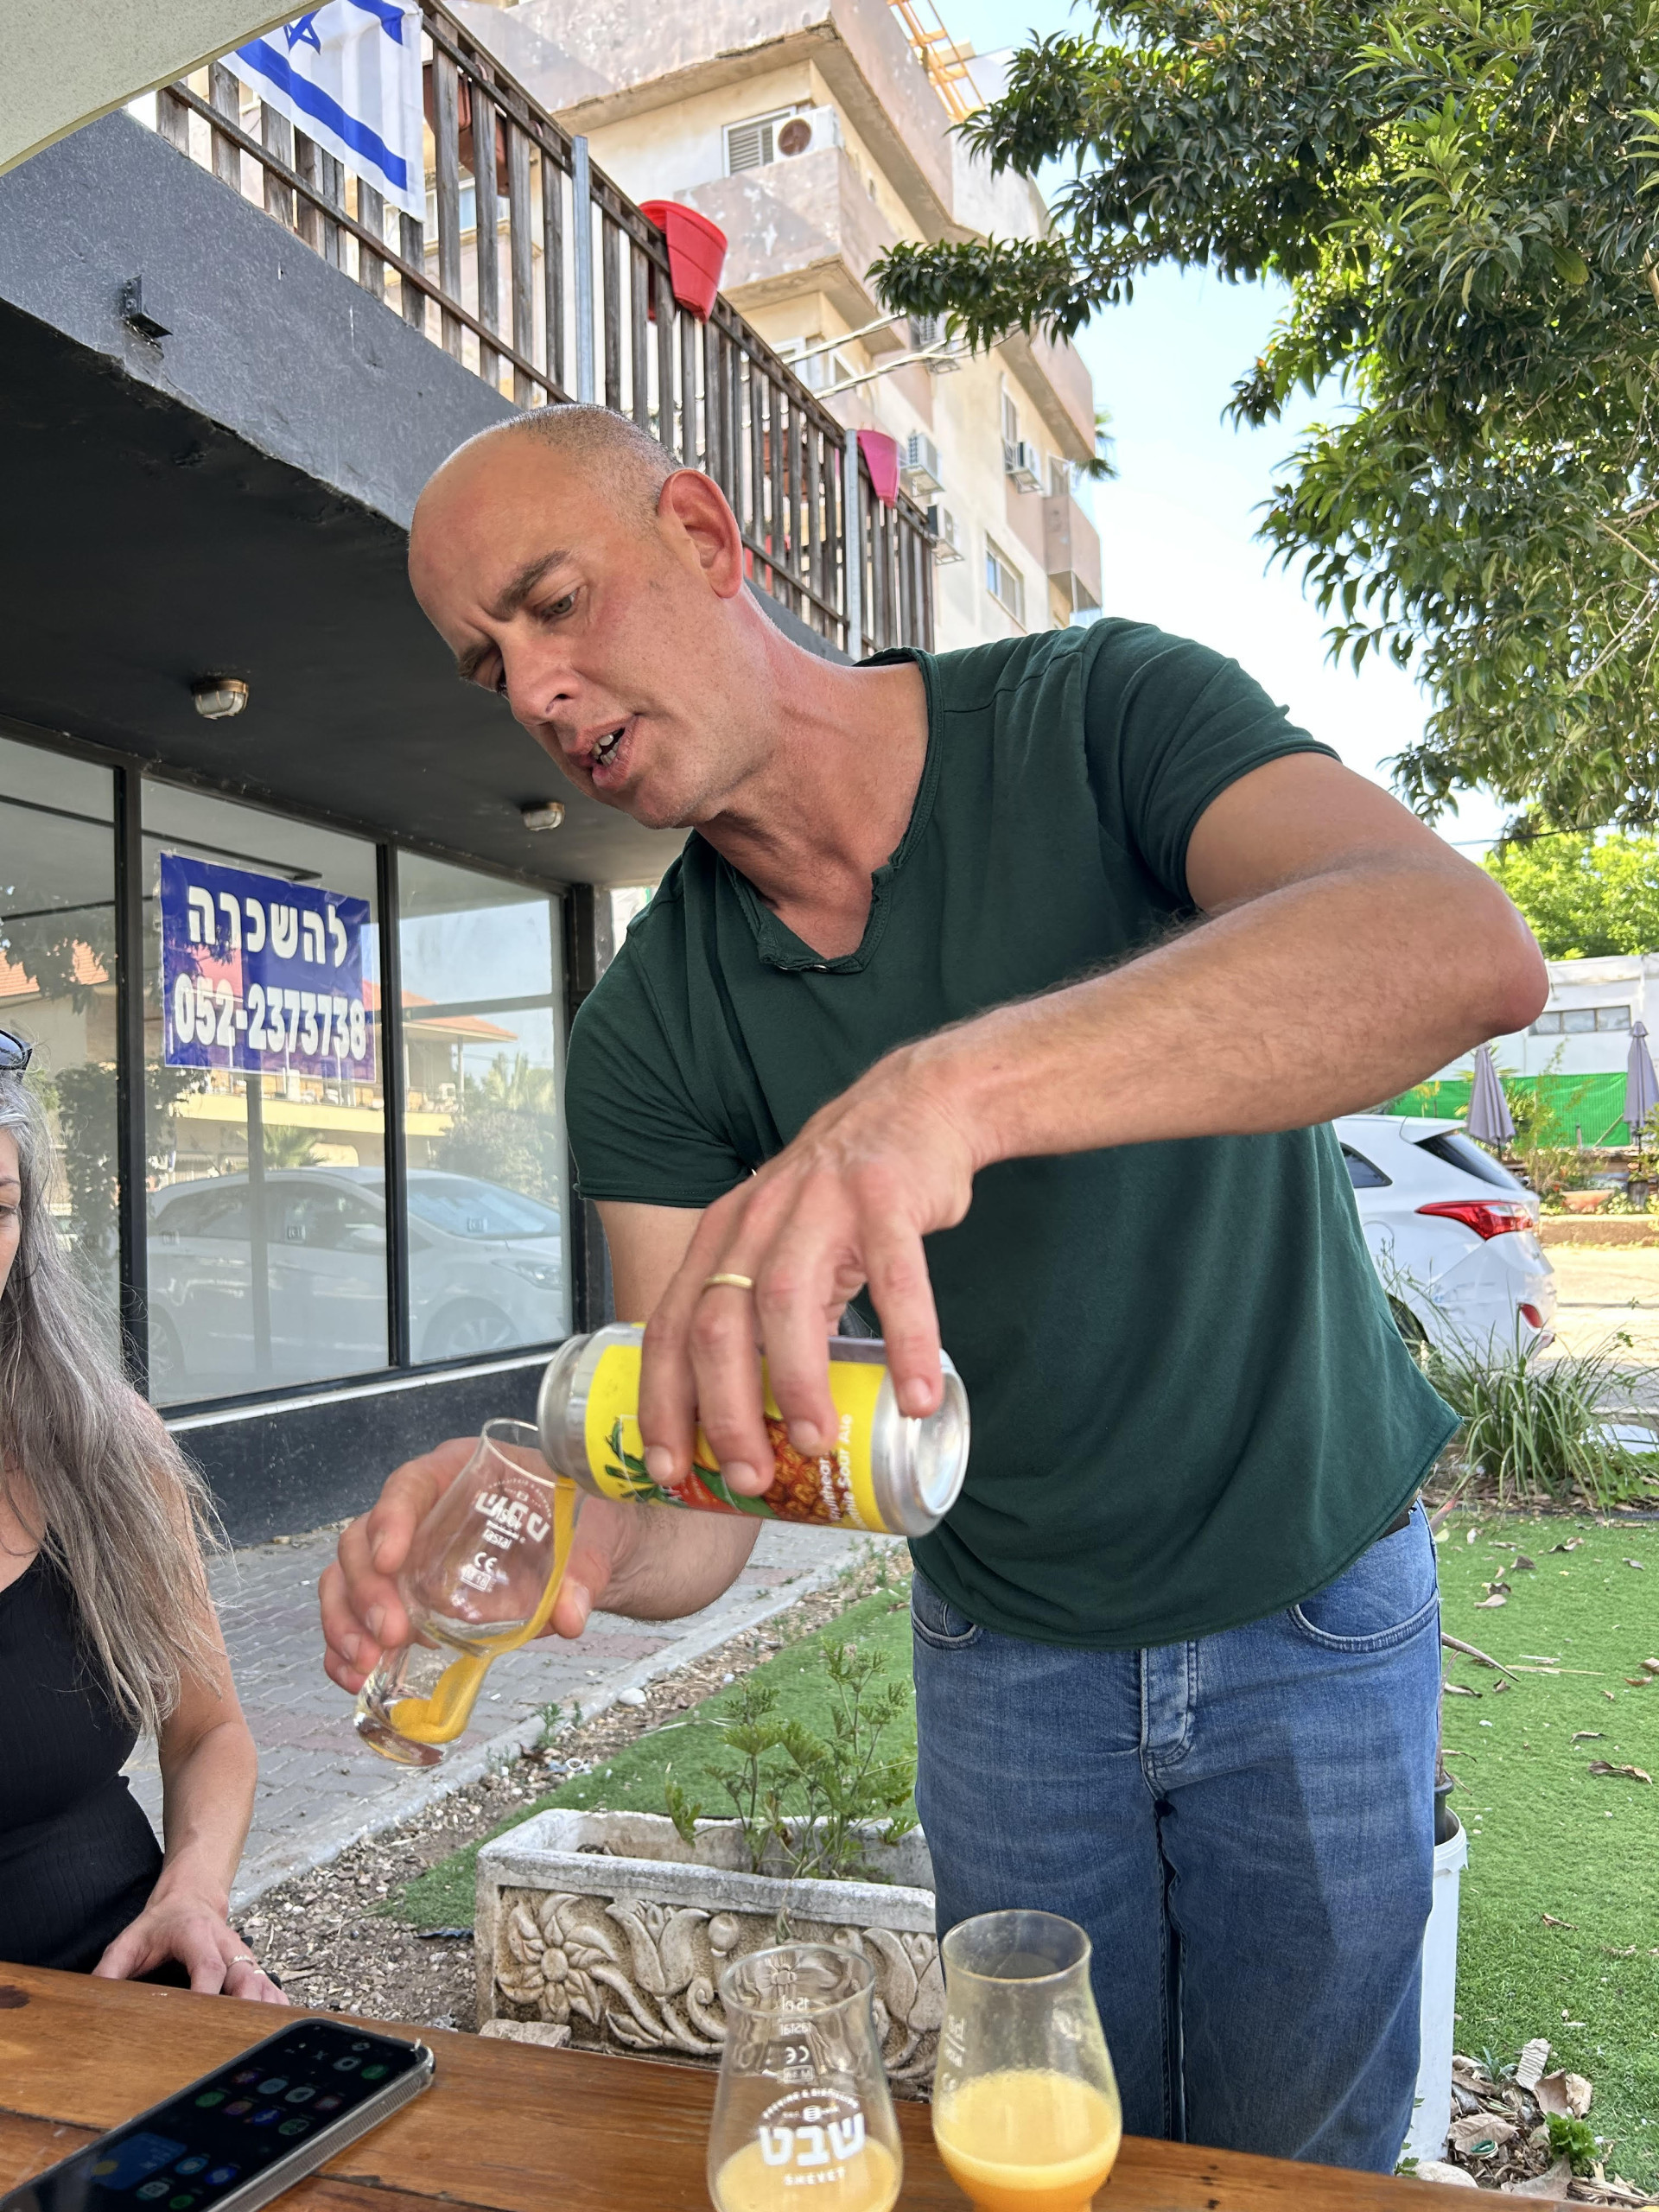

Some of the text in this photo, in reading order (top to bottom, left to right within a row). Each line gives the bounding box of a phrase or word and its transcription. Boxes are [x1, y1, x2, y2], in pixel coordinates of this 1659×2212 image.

[188, 885, 348, 969] להשכרה
[174, 972, 366, 1062] 052-2373738
[838, 1414, 853, 1445] Ale
[837, 1449, 852, 1489] Sour
[759, 2112, 865, 2166] שבט
[783, 2166, 846, 2186] SHEVET
